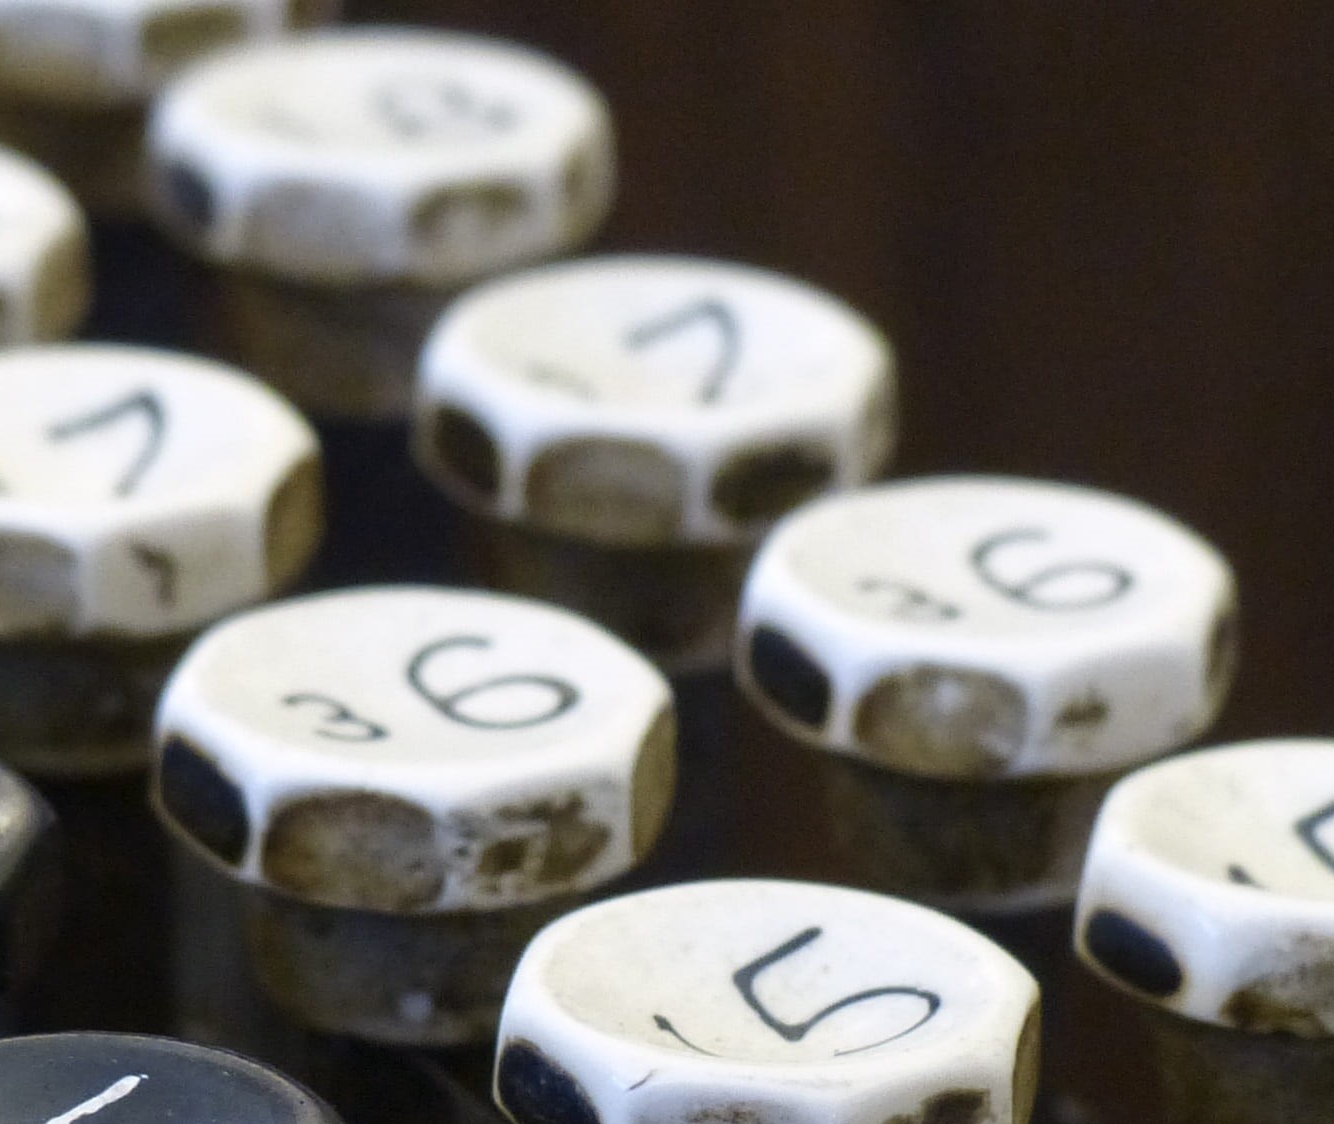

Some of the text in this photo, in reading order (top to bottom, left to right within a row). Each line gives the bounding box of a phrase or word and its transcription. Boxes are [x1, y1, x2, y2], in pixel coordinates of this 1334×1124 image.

[622, 297, 743, 403] 7
[43, 388, 170, 496] 7
[968, 525, 1136, 612] 6
[281, 633, 582, 744] 3 6
[732, 925, 942, 1055] 5
